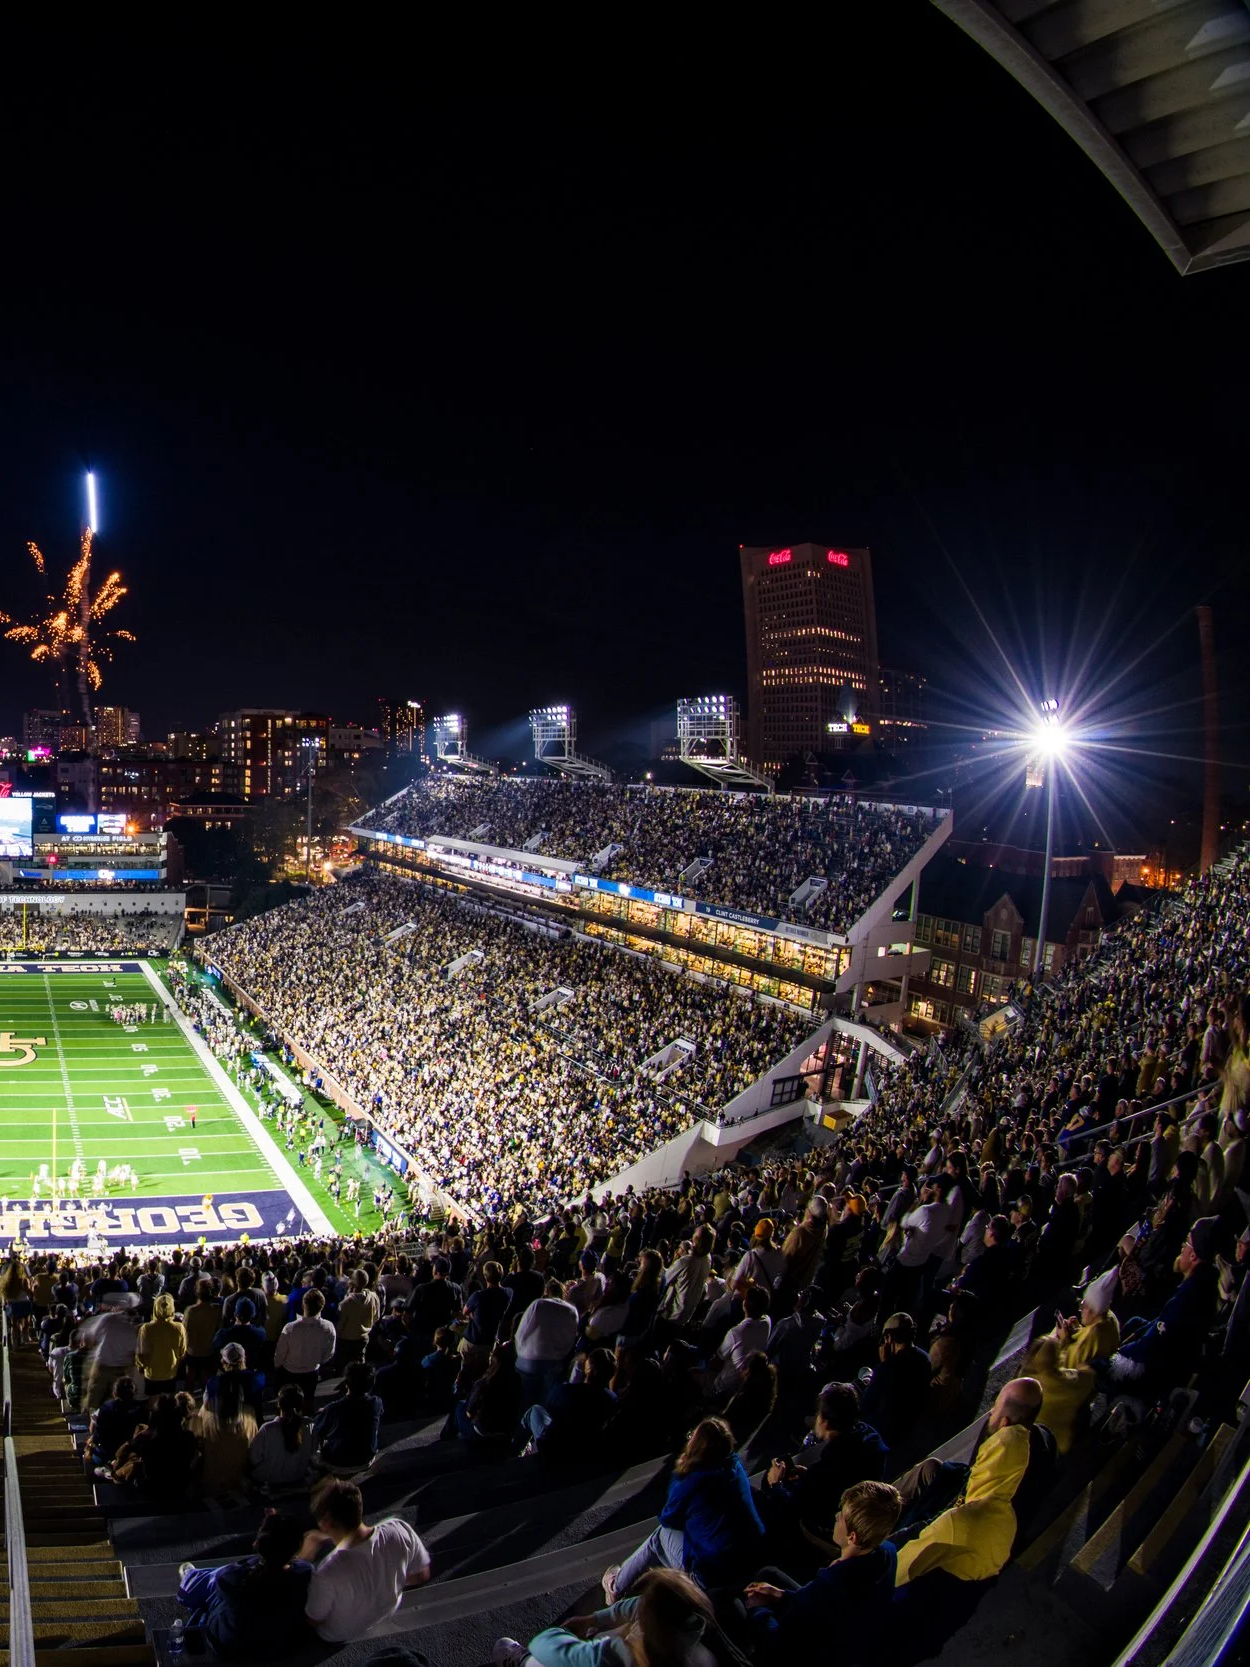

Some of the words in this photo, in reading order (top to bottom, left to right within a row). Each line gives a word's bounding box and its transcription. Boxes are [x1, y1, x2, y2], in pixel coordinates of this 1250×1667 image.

[828, 723, 848, 732] TECH
[9, 895, 65, 904] TECHNOLOGY
[716, 909, 729, 918] CLINT
[729, 911, 760, 925] CASTLEBERRY
[37, 964, 123, 973] TECH
